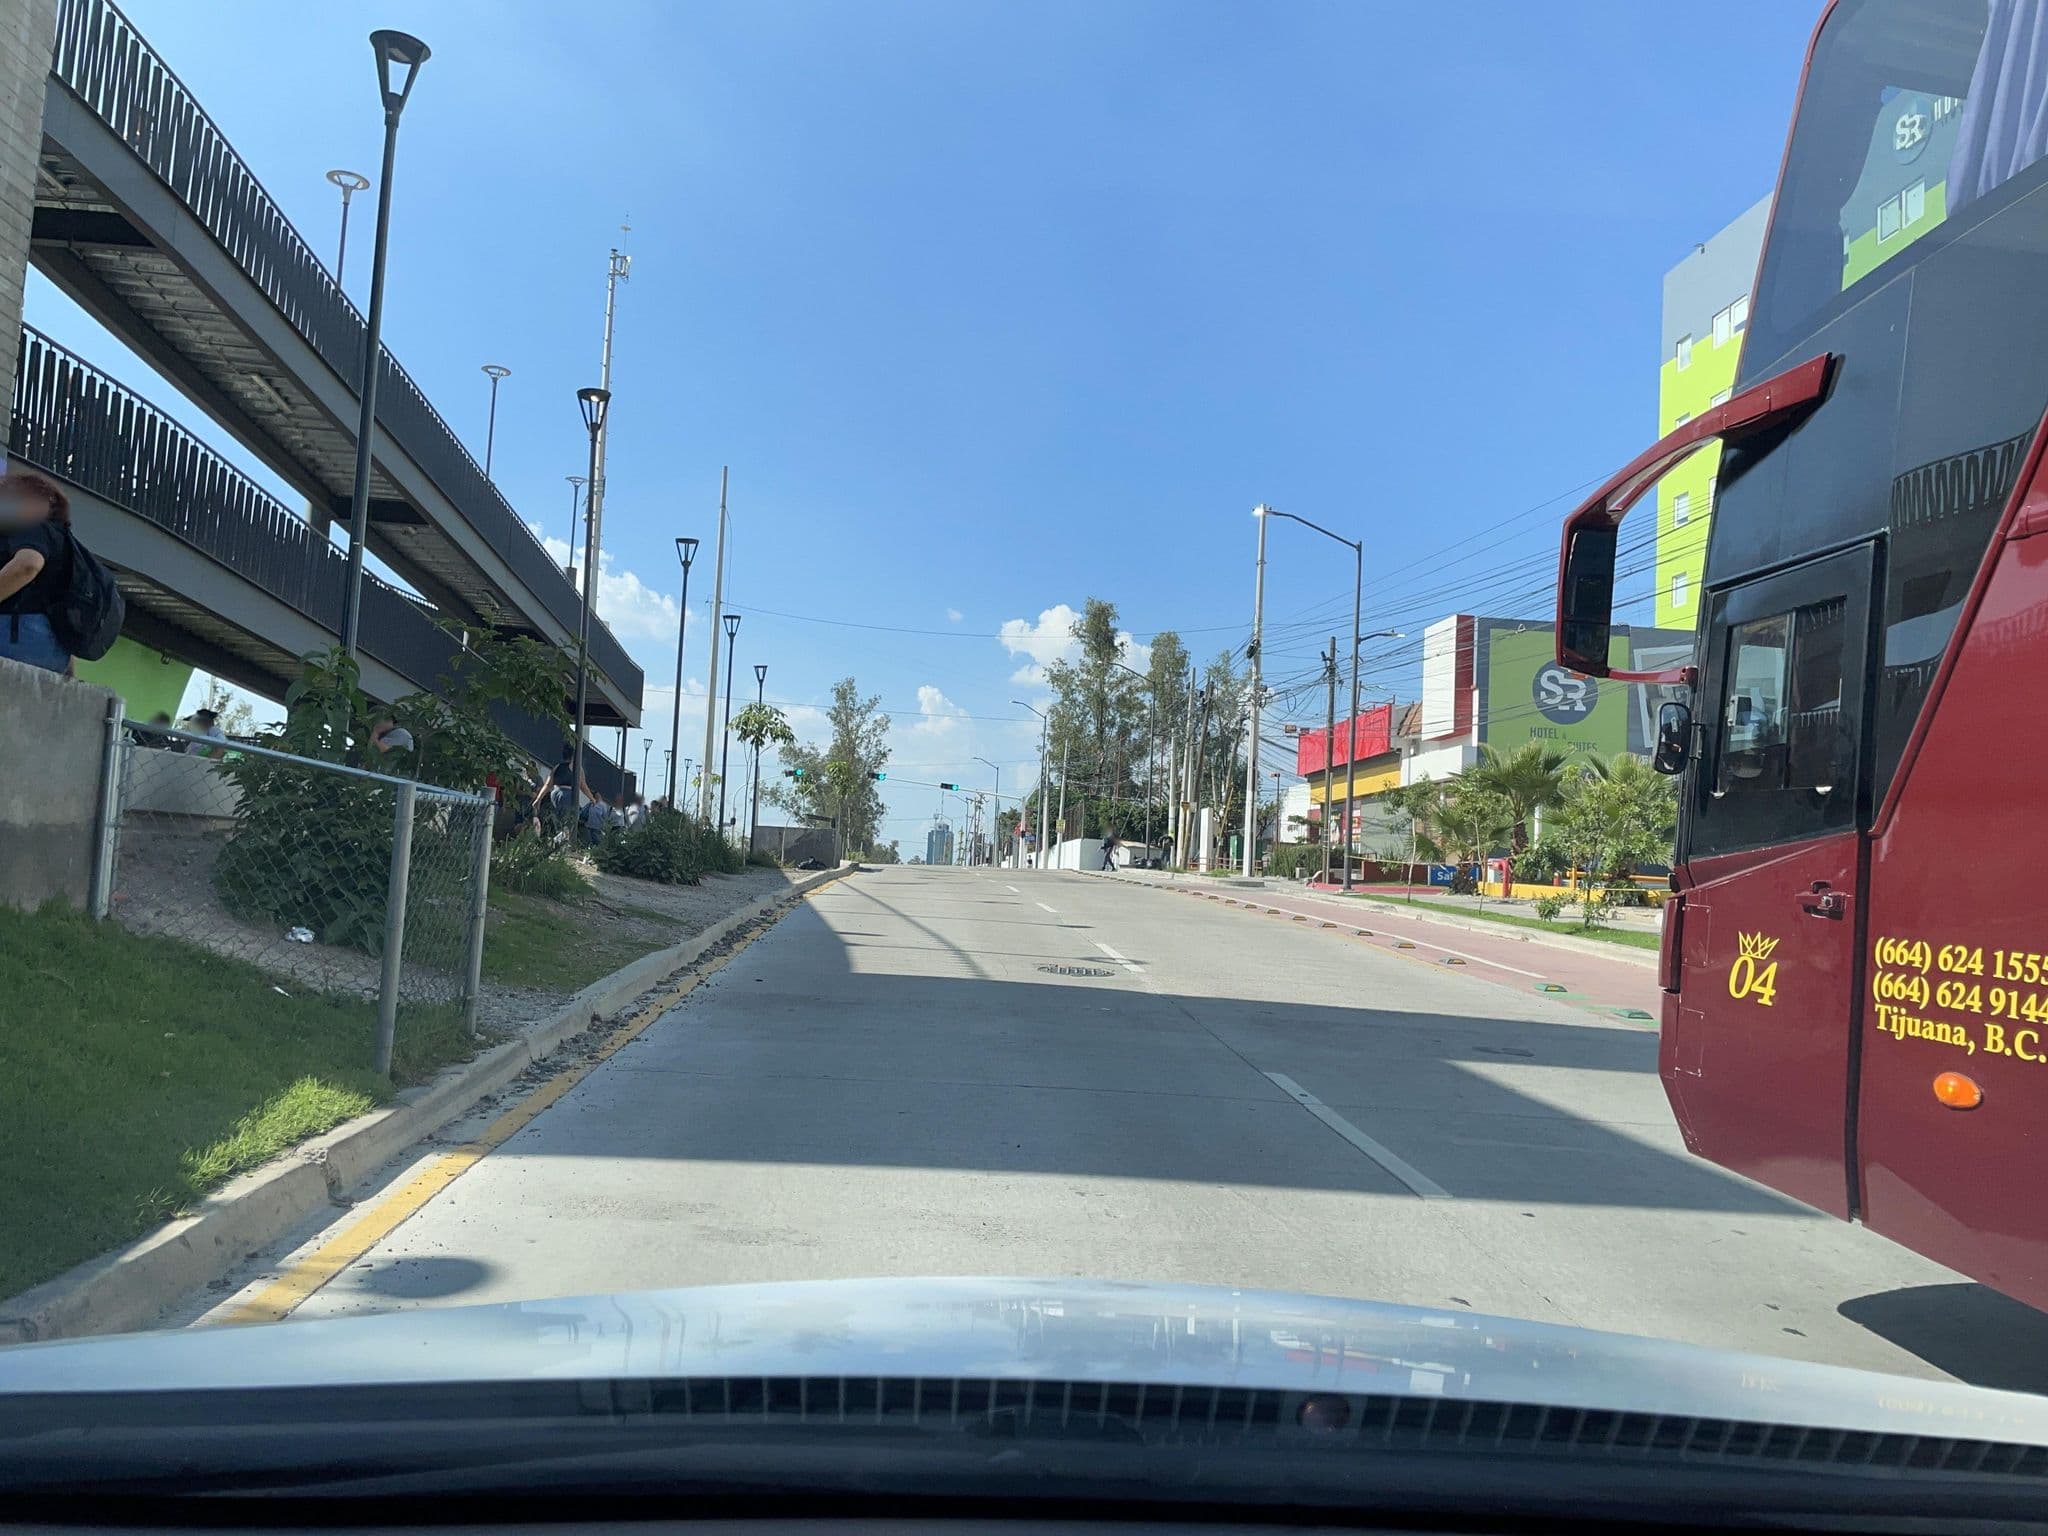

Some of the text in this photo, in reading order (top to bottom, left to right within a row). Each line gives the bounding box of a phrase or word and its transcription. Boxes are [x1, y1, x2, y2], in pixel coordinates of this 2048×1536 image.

[1530, 726, 1559, 739] HOTEL
[1728, 955, 1778, 1006] 04
[1875, 936, 1932, 975] (664)
[1937, 944, 1984, 976] 624
[1872, 970, 2048, 1025] (664) 624 9144
[1875, 1003, 2047, 1063] Tijuana, B.C.
